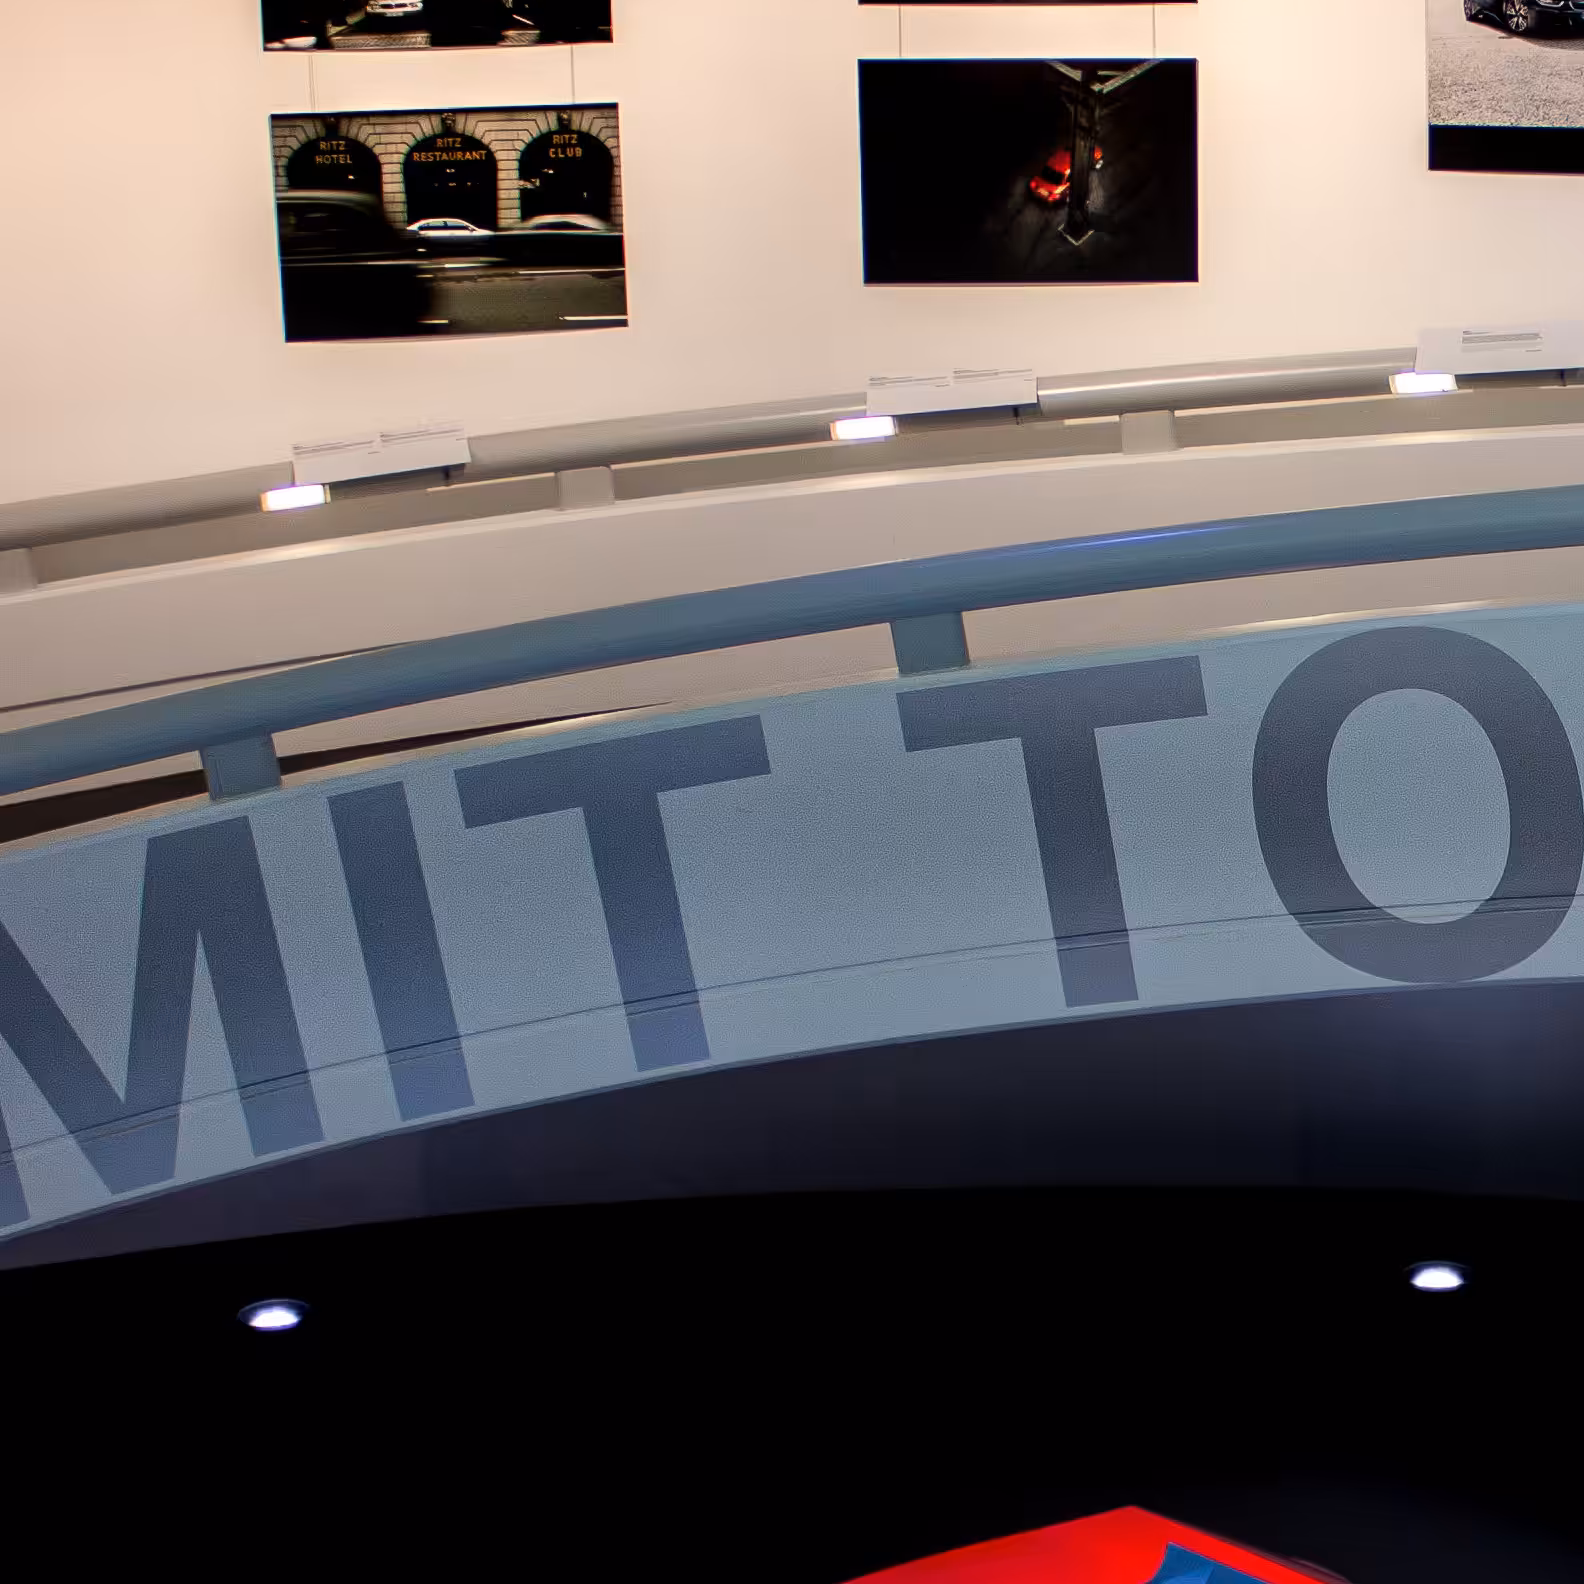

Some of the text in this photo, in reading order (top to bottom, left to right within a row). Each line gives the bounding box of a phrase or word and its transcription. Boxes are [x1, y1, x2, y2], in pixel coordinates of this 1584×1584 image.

[436, 137, 462, 147] RITZ
[553, 134, 578, 144] RITZ
[319, 140, 345, 151] RITZ
[412, 150, 487, 162] RESTAURANT
[549, 147, 582, 158] CLUB
[315, 154, 353, 164] HOTEL
